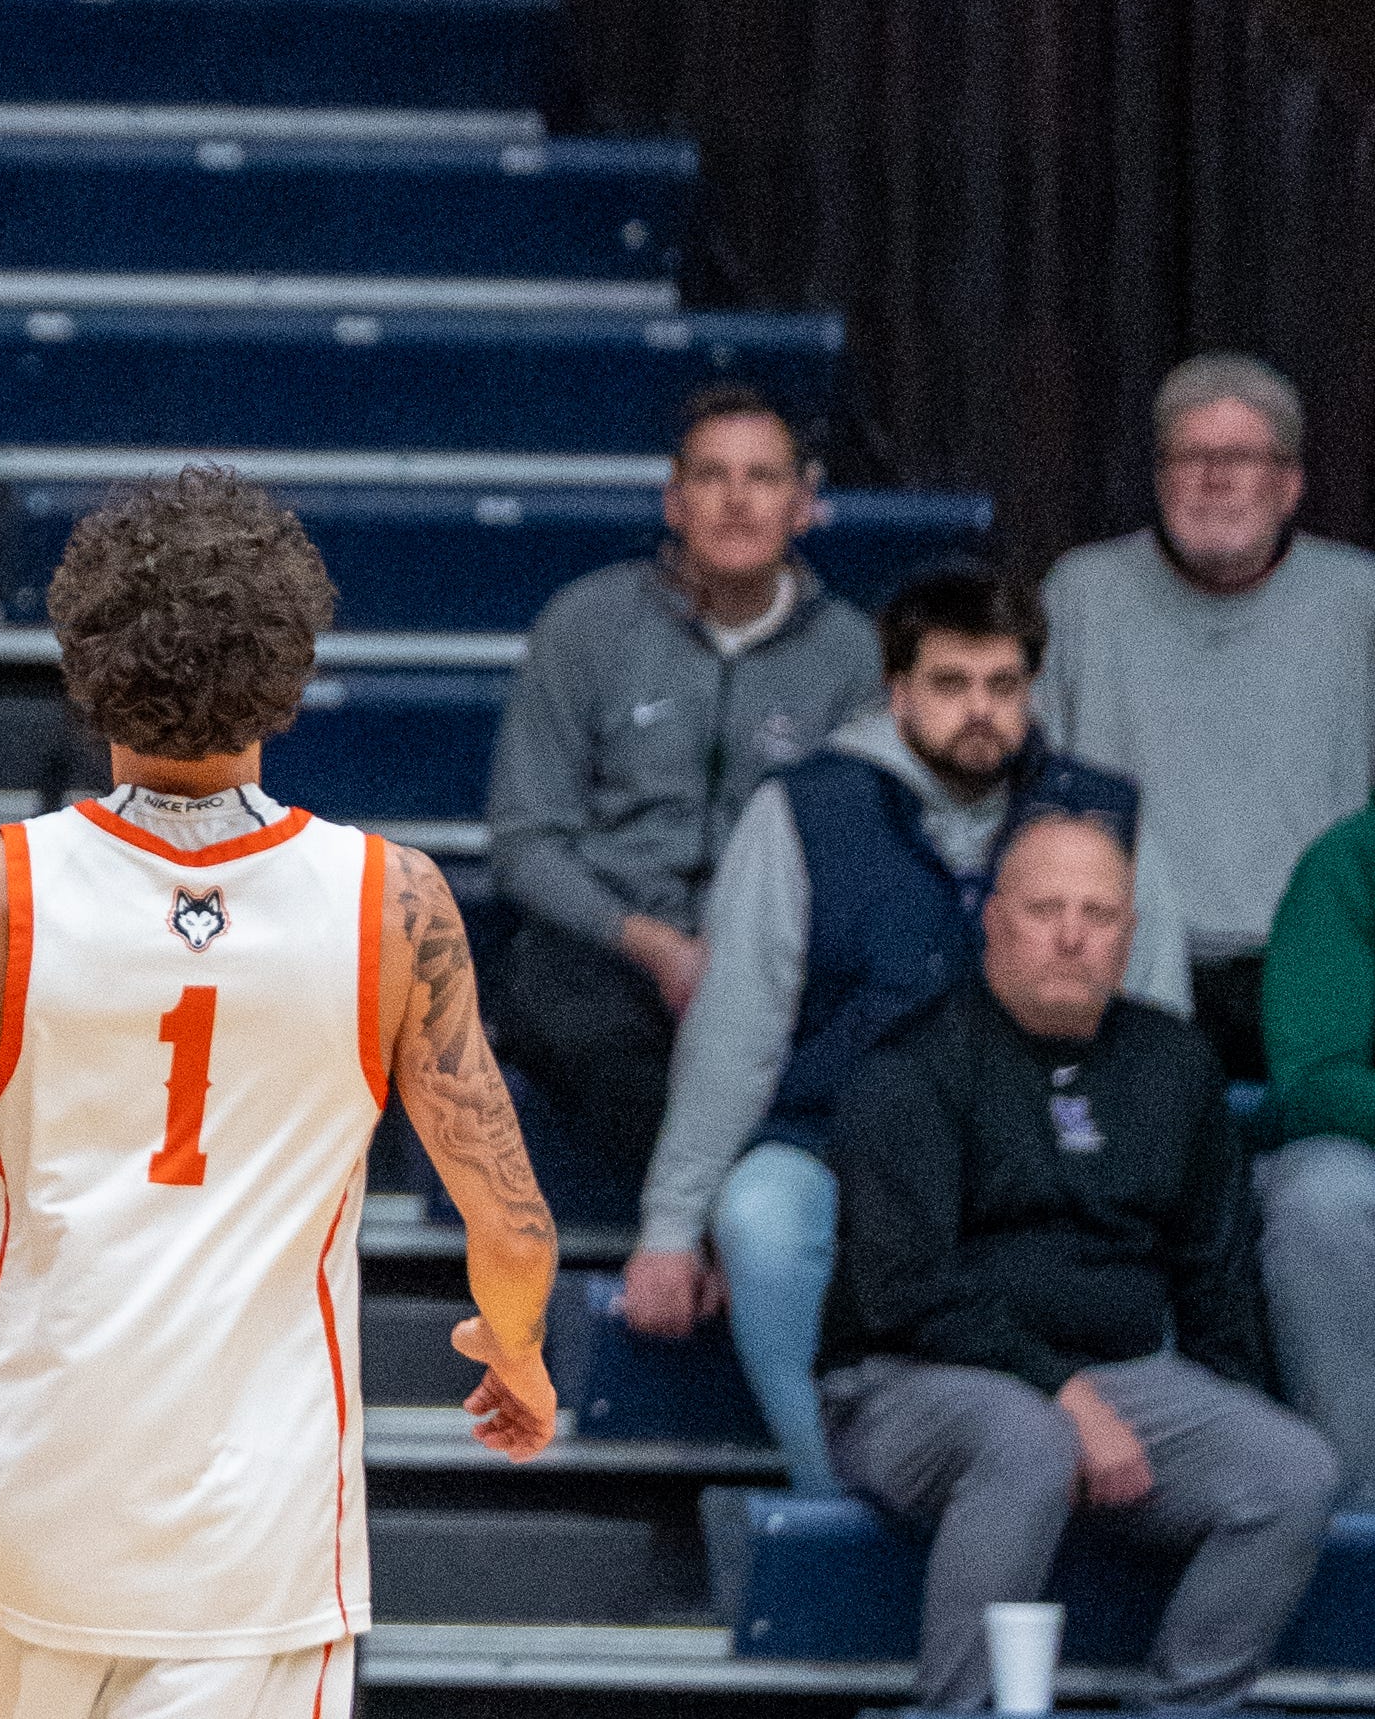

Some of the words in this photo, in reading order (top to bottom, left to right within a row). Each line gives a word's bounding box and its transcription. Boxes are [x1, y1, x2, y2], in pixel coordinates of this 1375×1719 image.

[144, 795, 183, 813] NIKE
[186, 797, 224, 813] PRO
[148, 985, 217, 1186] 1
